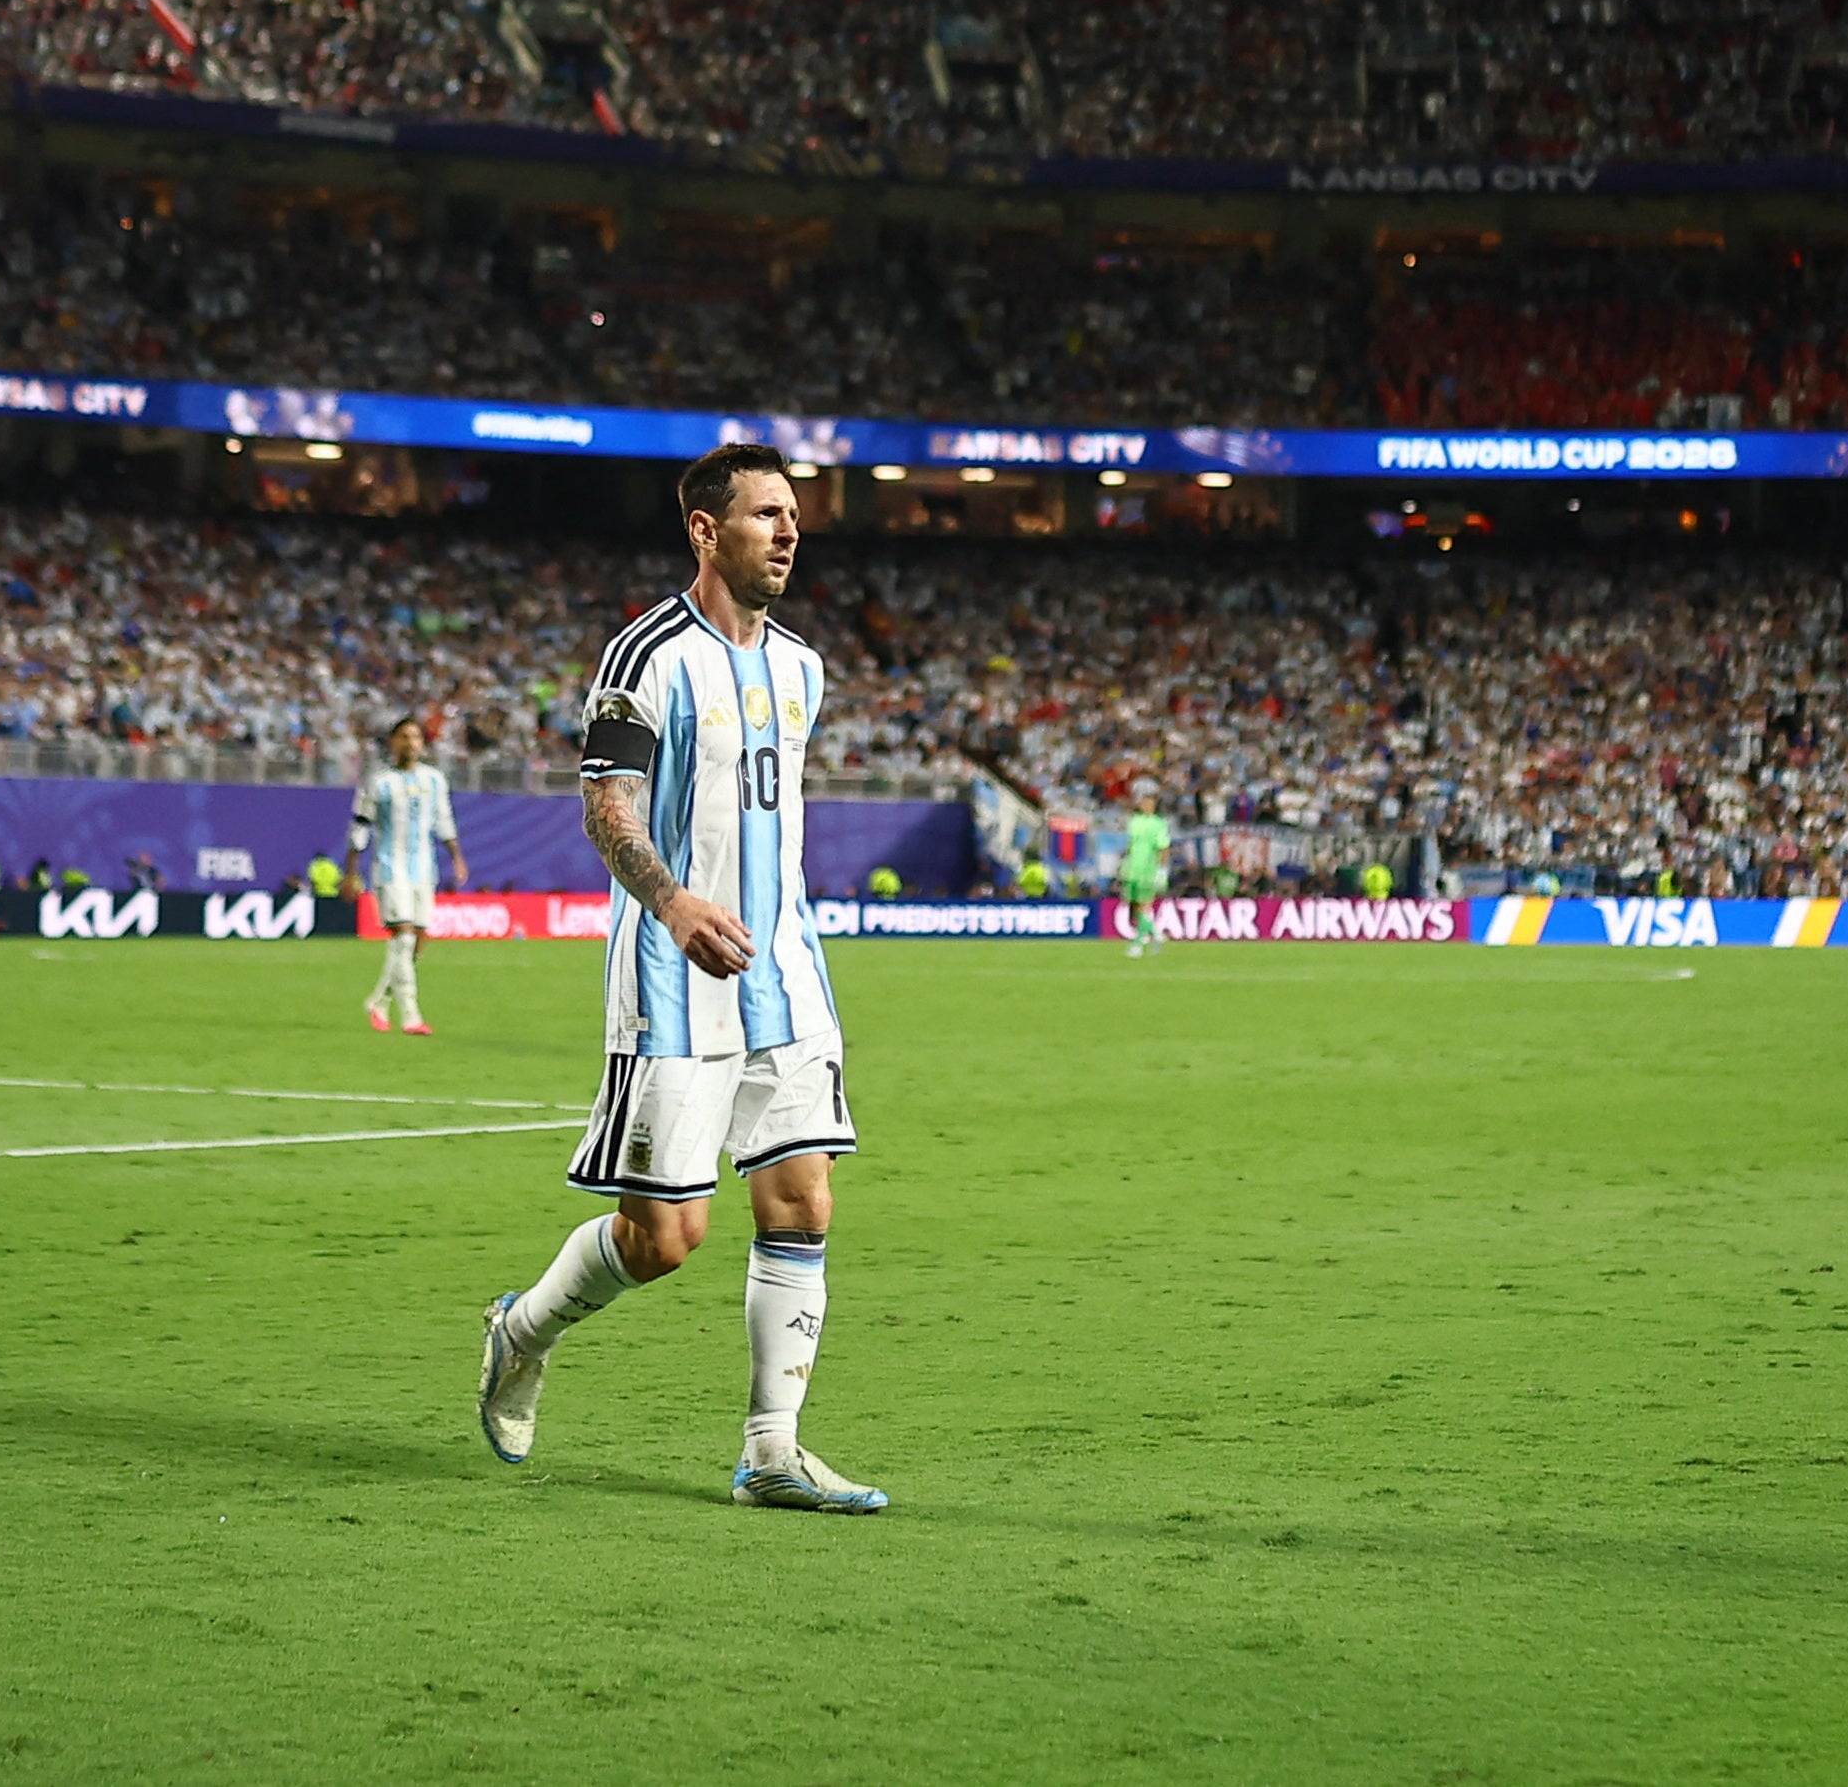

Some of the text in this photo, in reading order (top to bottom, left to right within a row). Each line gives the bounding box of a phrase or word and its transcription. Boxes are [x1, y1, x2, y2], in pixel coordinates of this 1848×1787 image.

[1288, 166, 1598, 191] KANSAS CITY
[1377, 437, 1447, 470] FIFA
[1449, 437, 1561, 470] WORLD
[1562, 437, 1627, 470] CUP
[736, 746, 780, 812] 10
[426, 901, 511, 939] enovo
[806, 900, 860, 935] DI
[1270, 897, 1455, 942] AIRWAYS
[1592, 896, 1718, 947] VISA
[826, 1060, 848, 1127] 1
